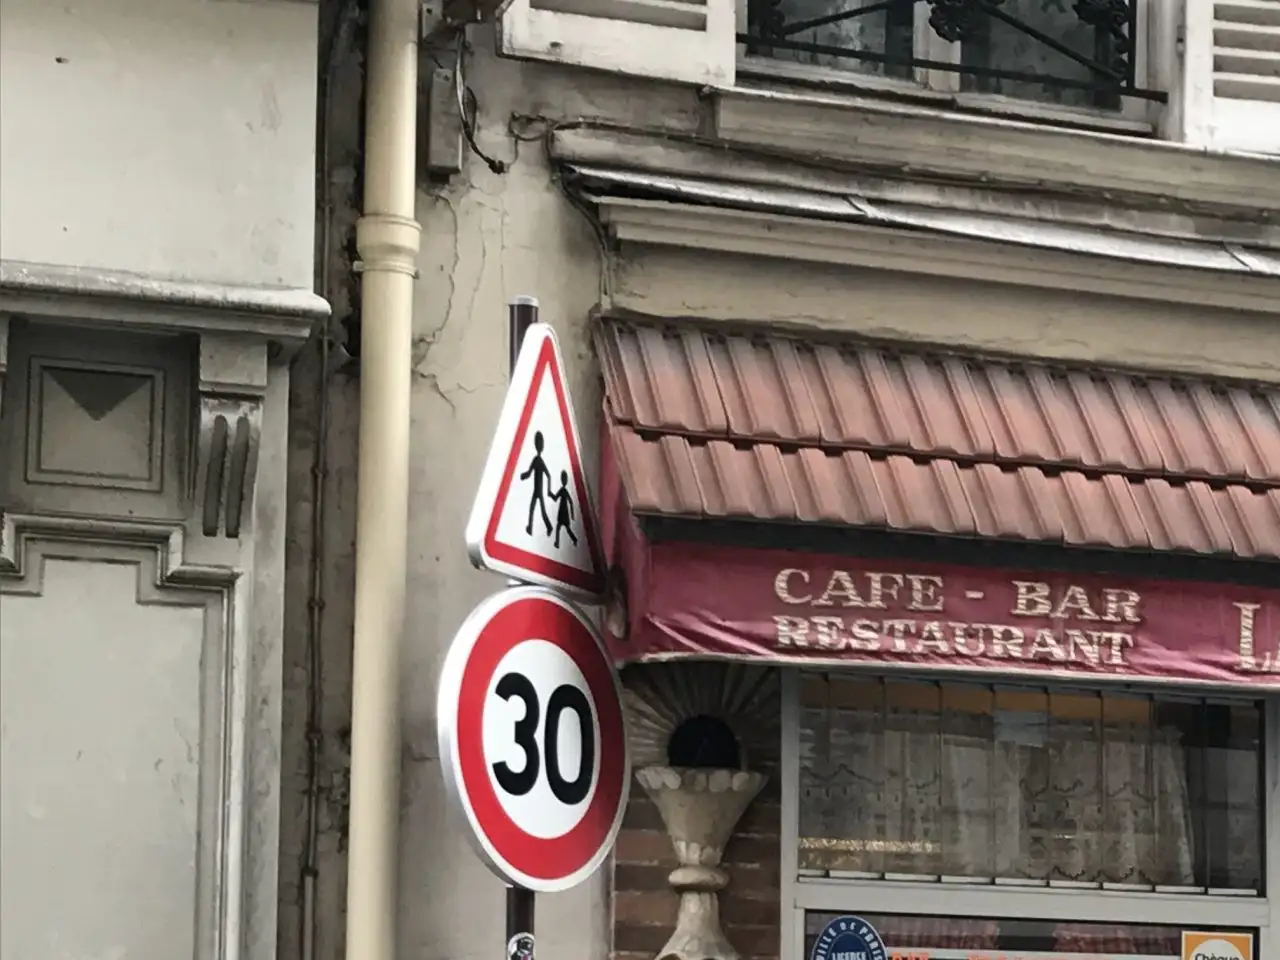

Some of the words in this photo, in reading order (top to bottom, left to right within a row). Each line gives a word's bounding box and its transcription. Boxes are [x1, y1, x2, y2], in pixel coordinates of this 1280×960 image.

[774, 568, 944, 612] CAFE
[1011, 579, 1141, 623] BAR
[772, 615, 1134, 667] RESTAURANT
[492, 672, 594, 805] 30
